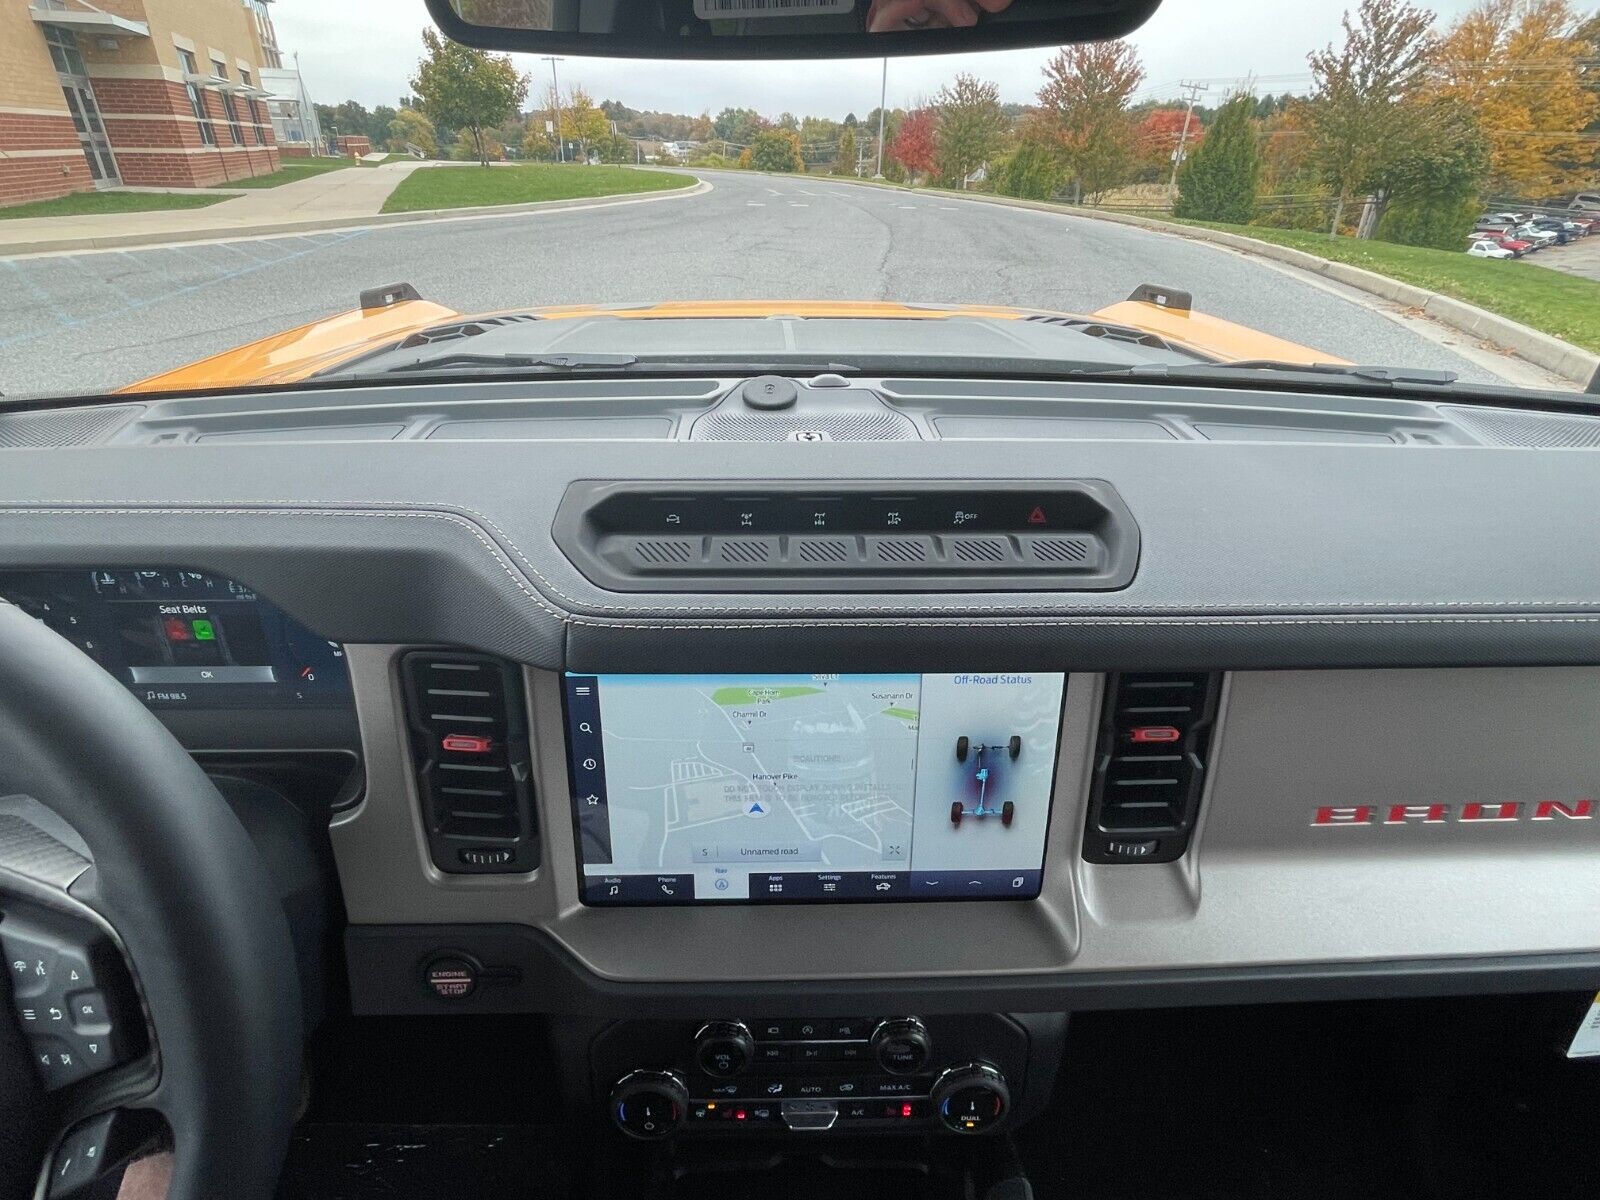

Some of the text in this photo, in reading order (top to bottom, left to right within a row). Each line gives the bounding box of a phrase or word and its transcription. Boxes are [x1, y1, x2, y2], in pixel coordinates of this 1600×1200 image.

[159, 604, 207, 614] Seat Belts
[201, 671, 214, 679] OK
[954, 675, 1032, 685] Off-Road Status
[740, 848, 779, 856] Unnamed
